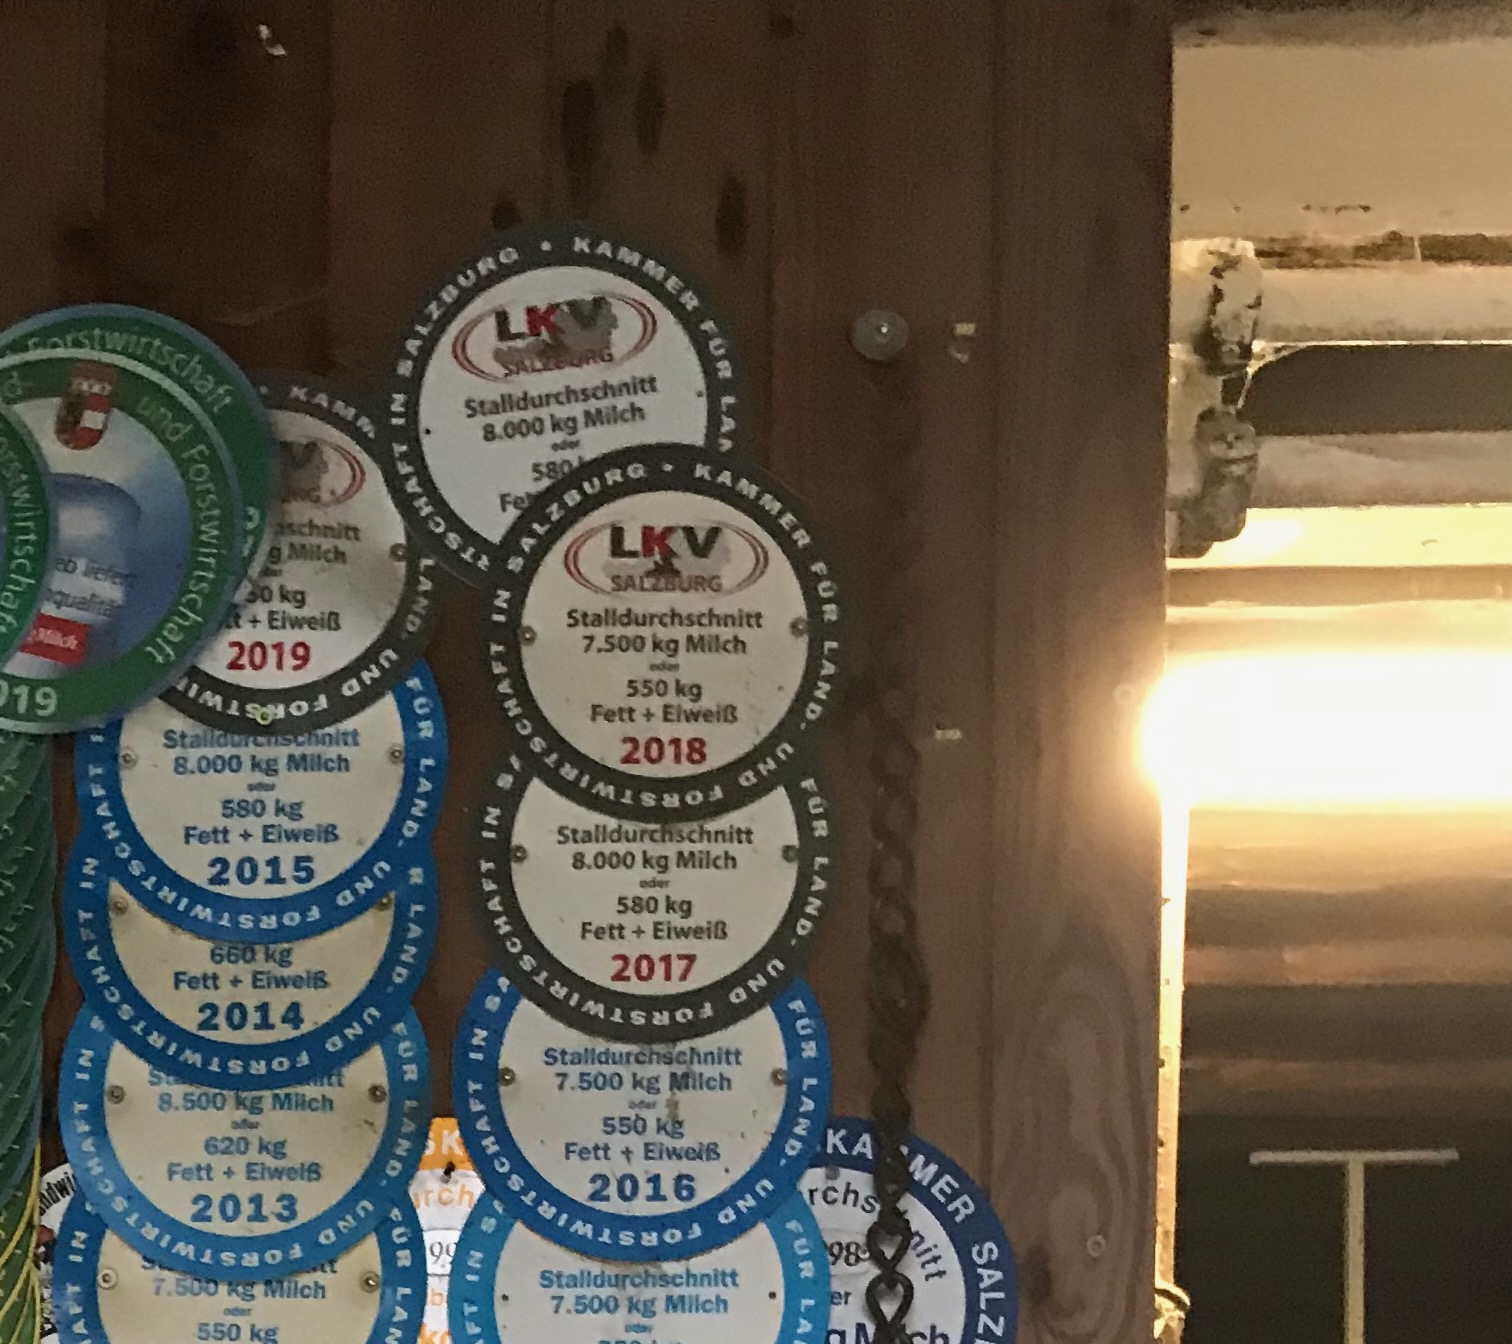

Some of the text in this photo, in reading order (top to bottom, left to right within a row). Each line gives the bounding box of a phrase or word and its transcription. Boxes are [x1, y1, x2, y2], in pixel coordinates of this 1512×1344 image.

[611, 525, 721, 558] LKV
[611, 575, 722, 591] SALZBURG
[567, 608, 762, 628] Stalldurchschnitt
[227, 641, 310, 671] 2019
[583, 634, 746, 657] 7.500 kg Milch
[627, 679, 702, 703] 550 kg
[591, 704, 636, 723] Fett
[663, 704, 737, 723] Eiweiß
[621, 737, 706, 764] 2018
[208, 856, 314, 886] 2015
[611, 954, 696, 981] 2017
[198, 1002, 304, 1030] 2014
[589, 1174, 695, 1202] 2016
[192, 1194, 297, 1222] 2013
[541, 1269, 737, 1289] Stalldurchschnitt
[551, 1295, 727, 1318] 7.500 kg Milch
